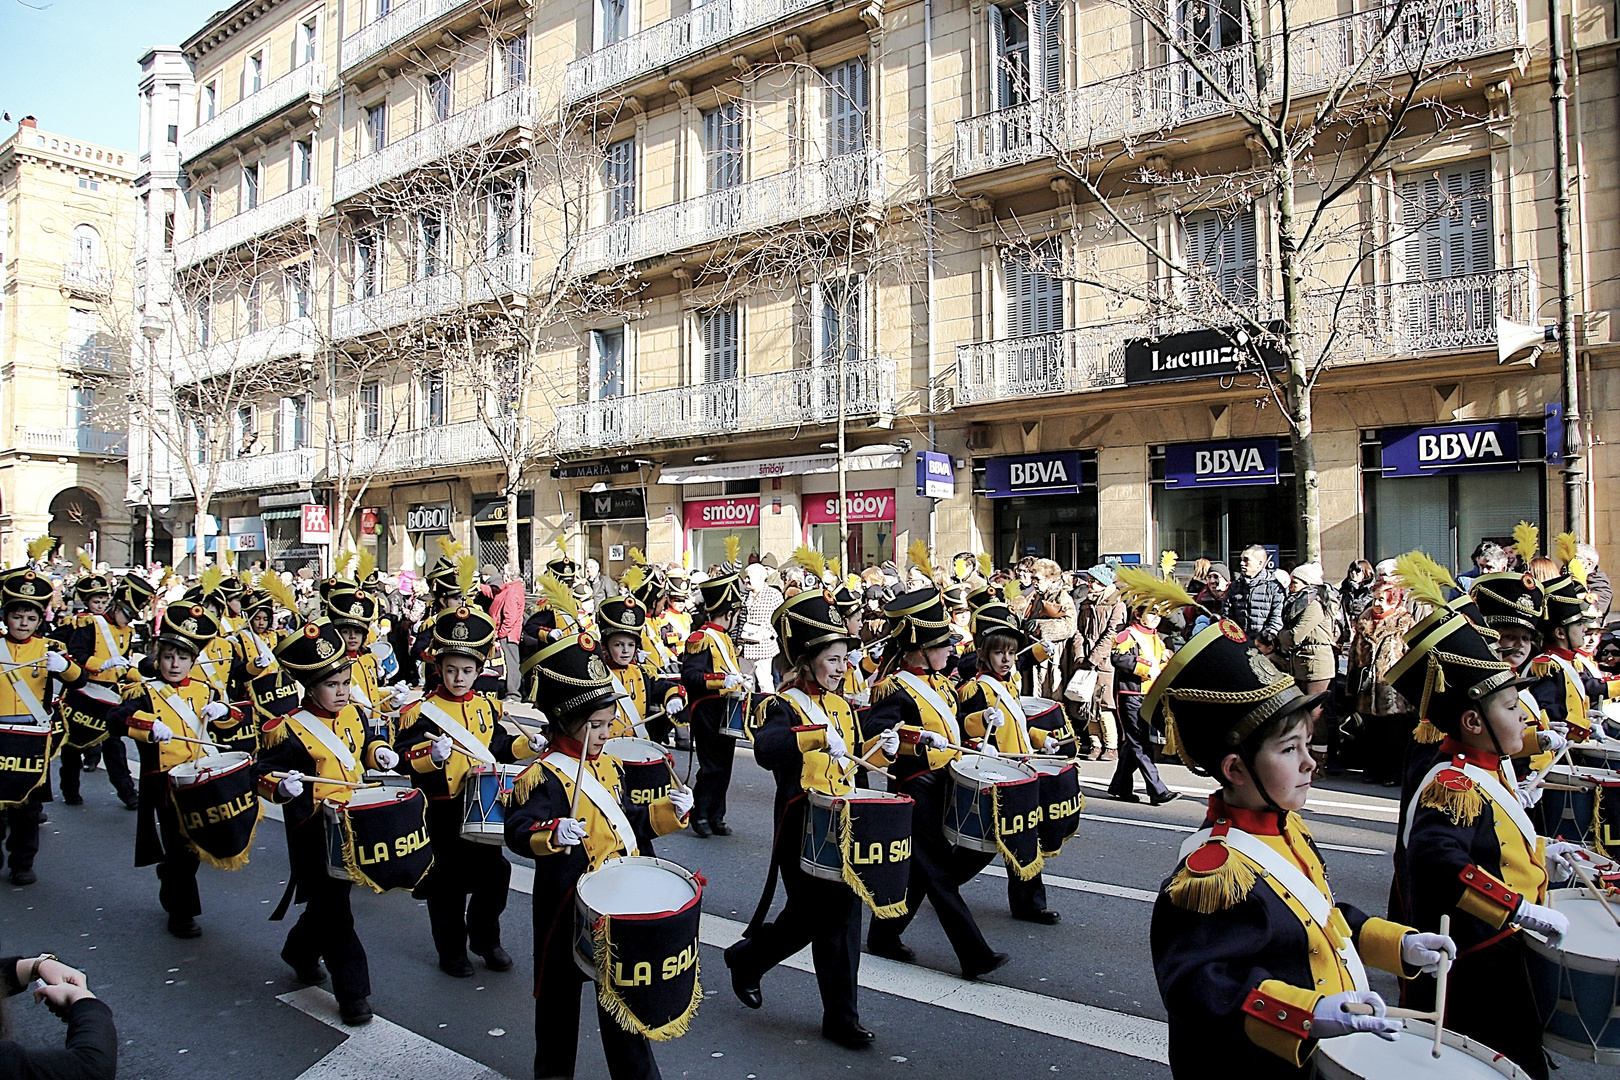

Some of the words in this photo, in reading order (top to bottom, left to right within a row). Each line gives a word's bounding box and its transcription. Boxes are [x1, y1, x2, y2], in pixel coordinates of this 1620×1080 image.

[1151, 346, 1244, 371] Lacunza
[1419, 430, 1503, 462] BBVA
[576, 464, 611, 477] MARTA
[929, 460, 950, 476] BBVA
[1010, 461, 1067, 485] BBVA
[1195, 448, 1264, 474] BBVA
[614, 500, 635, 508] MARTA
[703, 500, 755, 524] smöoy
[825, 492, 888, 518] smöoy
[239, 535, 256, 548] GAES
[258, 691, 275, 705] LA
[275, 683, 298, 699] SALL
[183, 812, 203, 830] LA
[205, 791, 253, 824] SALLE
[1000, 814, 1024, 836] LA
[358, 842, 390, 865] LA
[395, 826, 431, 857] SALL
[854, 842, 883, 865] LA
[615, 961, 652, 987] LA
